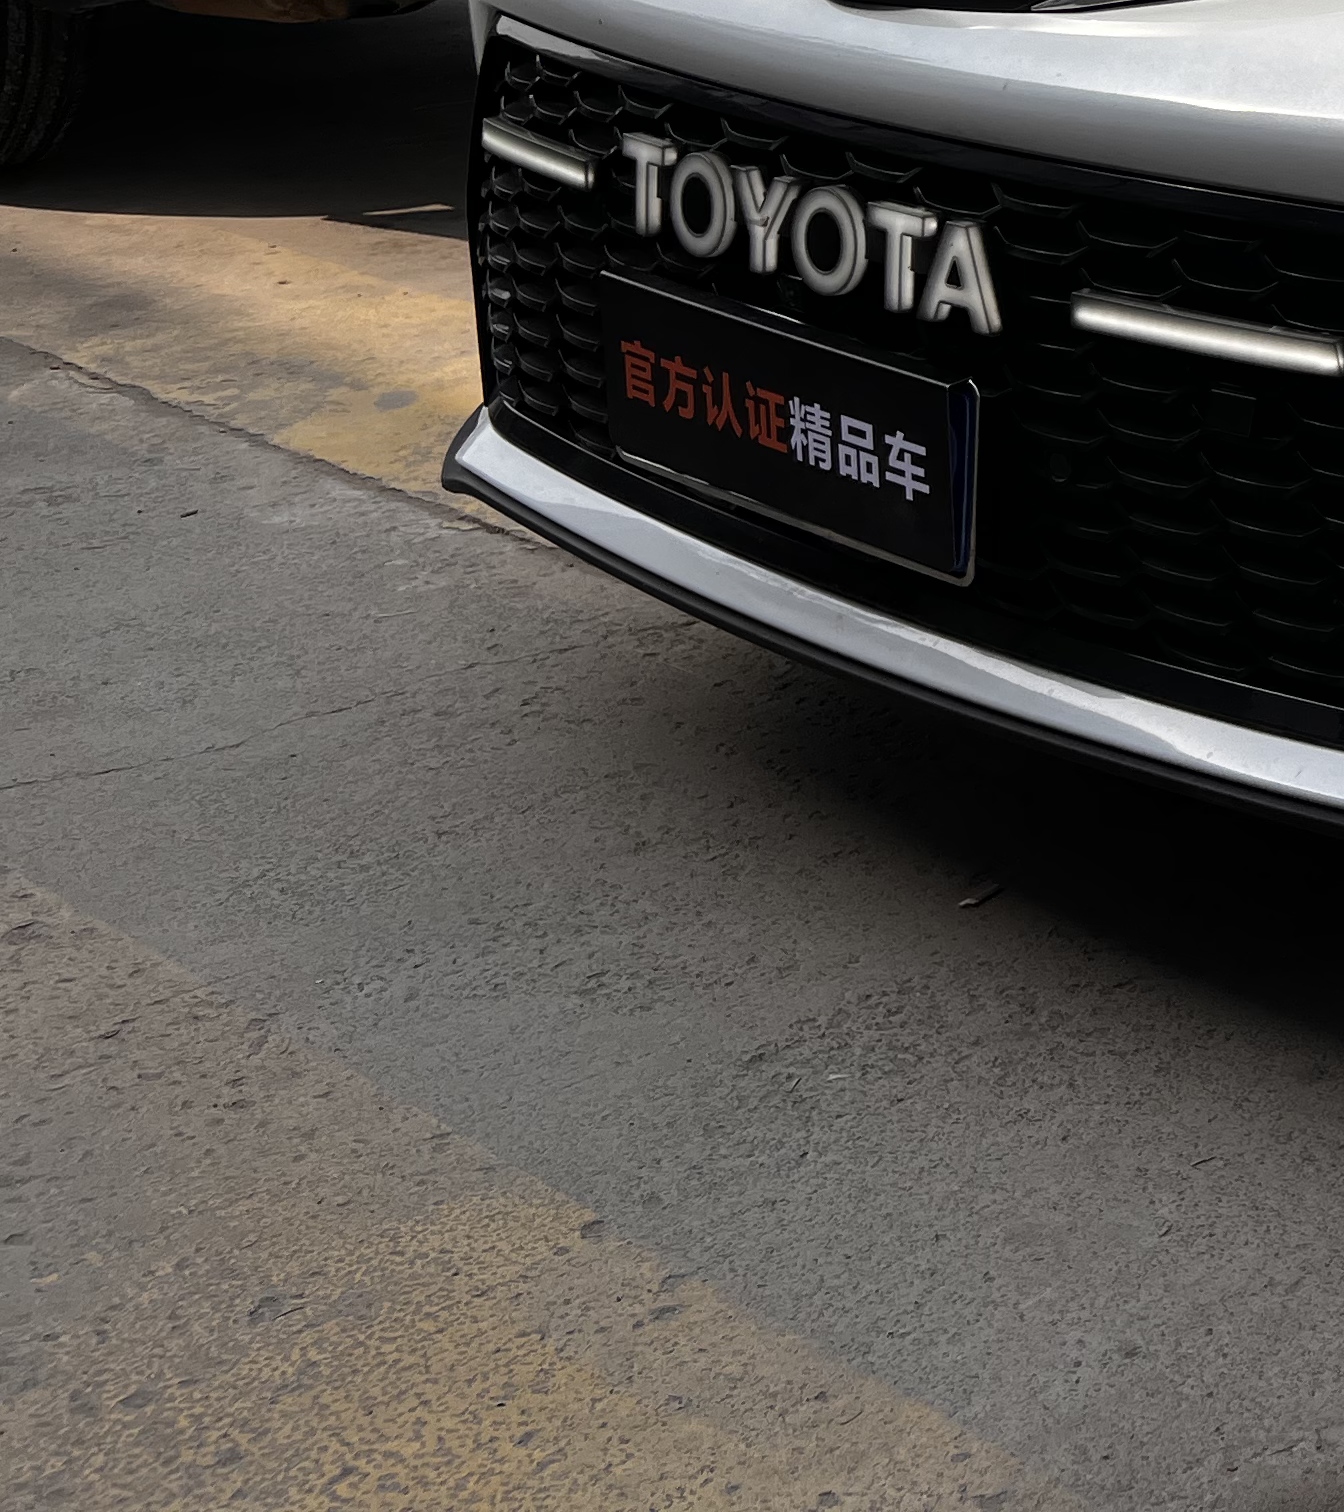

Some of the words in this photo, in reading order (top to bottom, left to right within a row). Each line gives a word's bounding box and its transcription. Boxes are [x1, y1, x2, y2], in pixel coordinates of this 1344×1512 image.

[621, 132, 1003, 336] TOYOTA
[620, 340, 930, 501] 官方认证精品车
